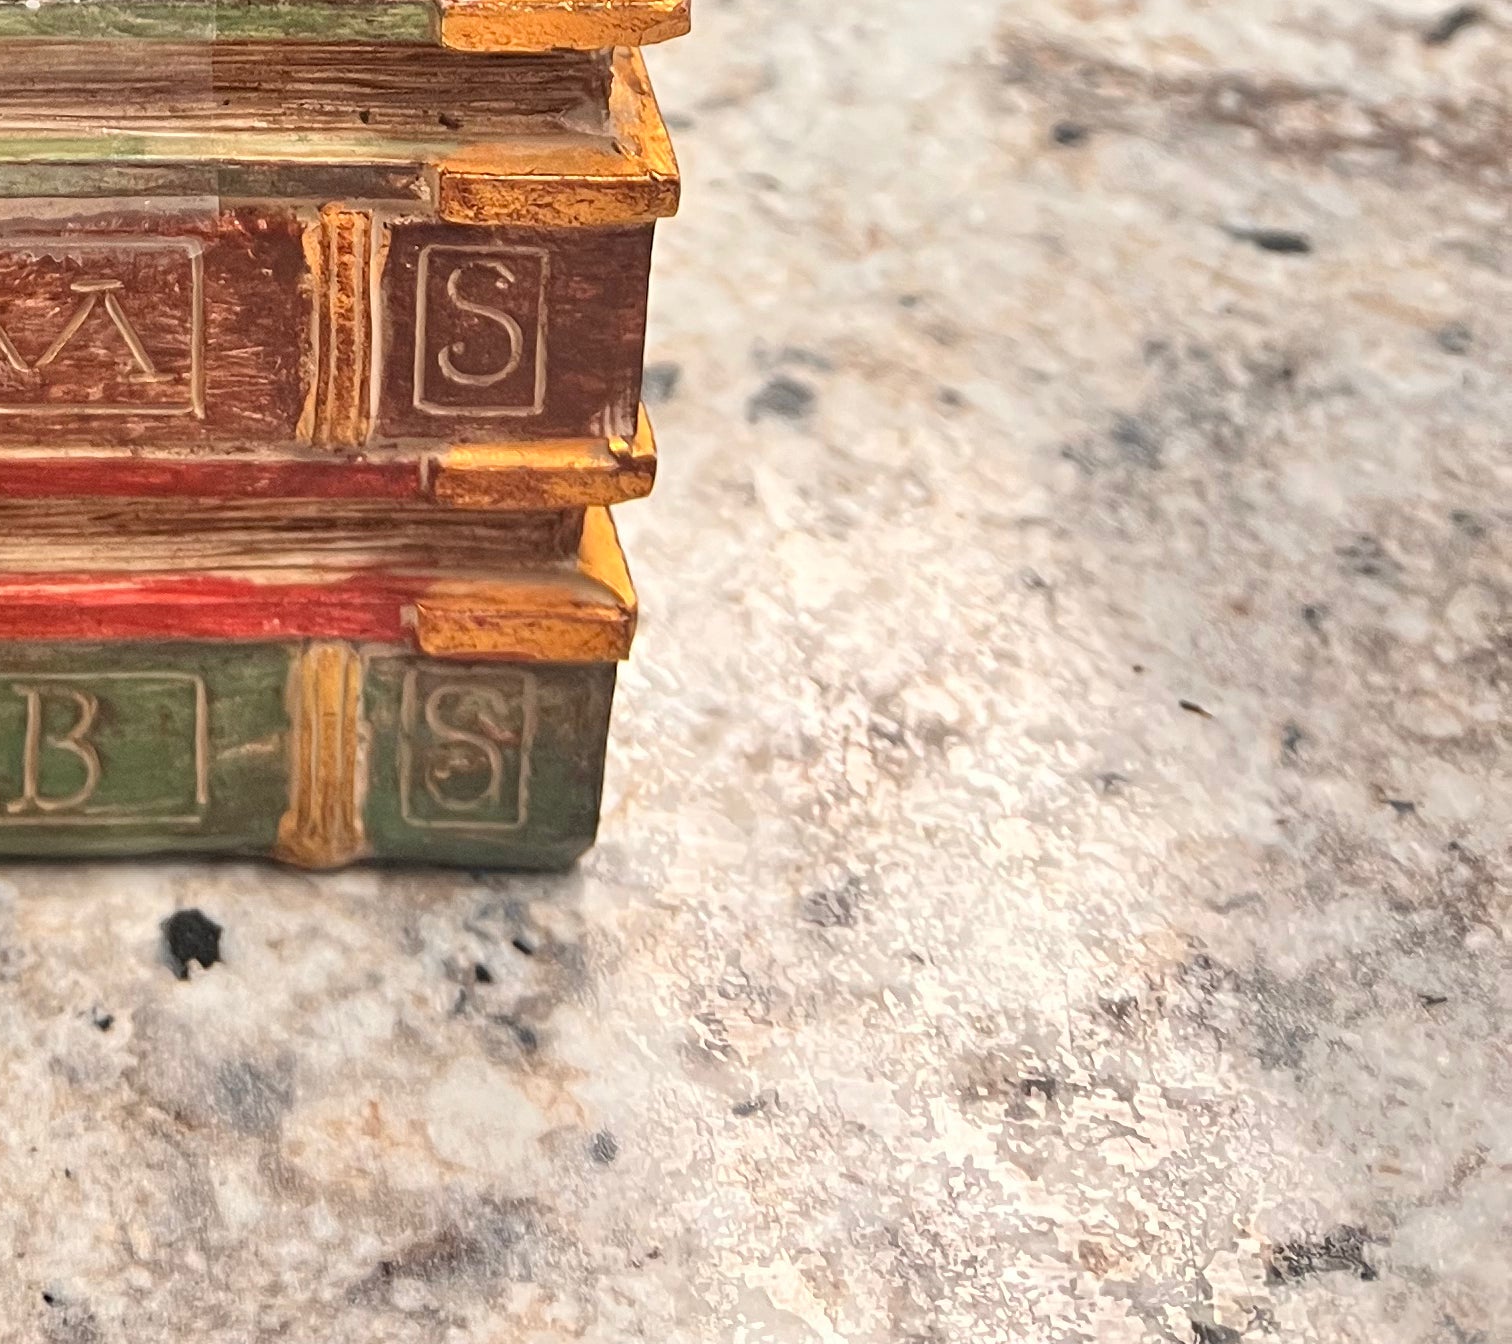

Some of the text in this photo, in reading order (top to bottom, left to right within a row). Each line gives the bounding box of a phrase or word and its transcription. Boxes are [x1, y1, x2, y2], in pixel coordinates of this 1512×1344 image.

[438, 260, 524, 387] S
[6, 682, 102, 814] B
[424, 684, 510, 812] S
